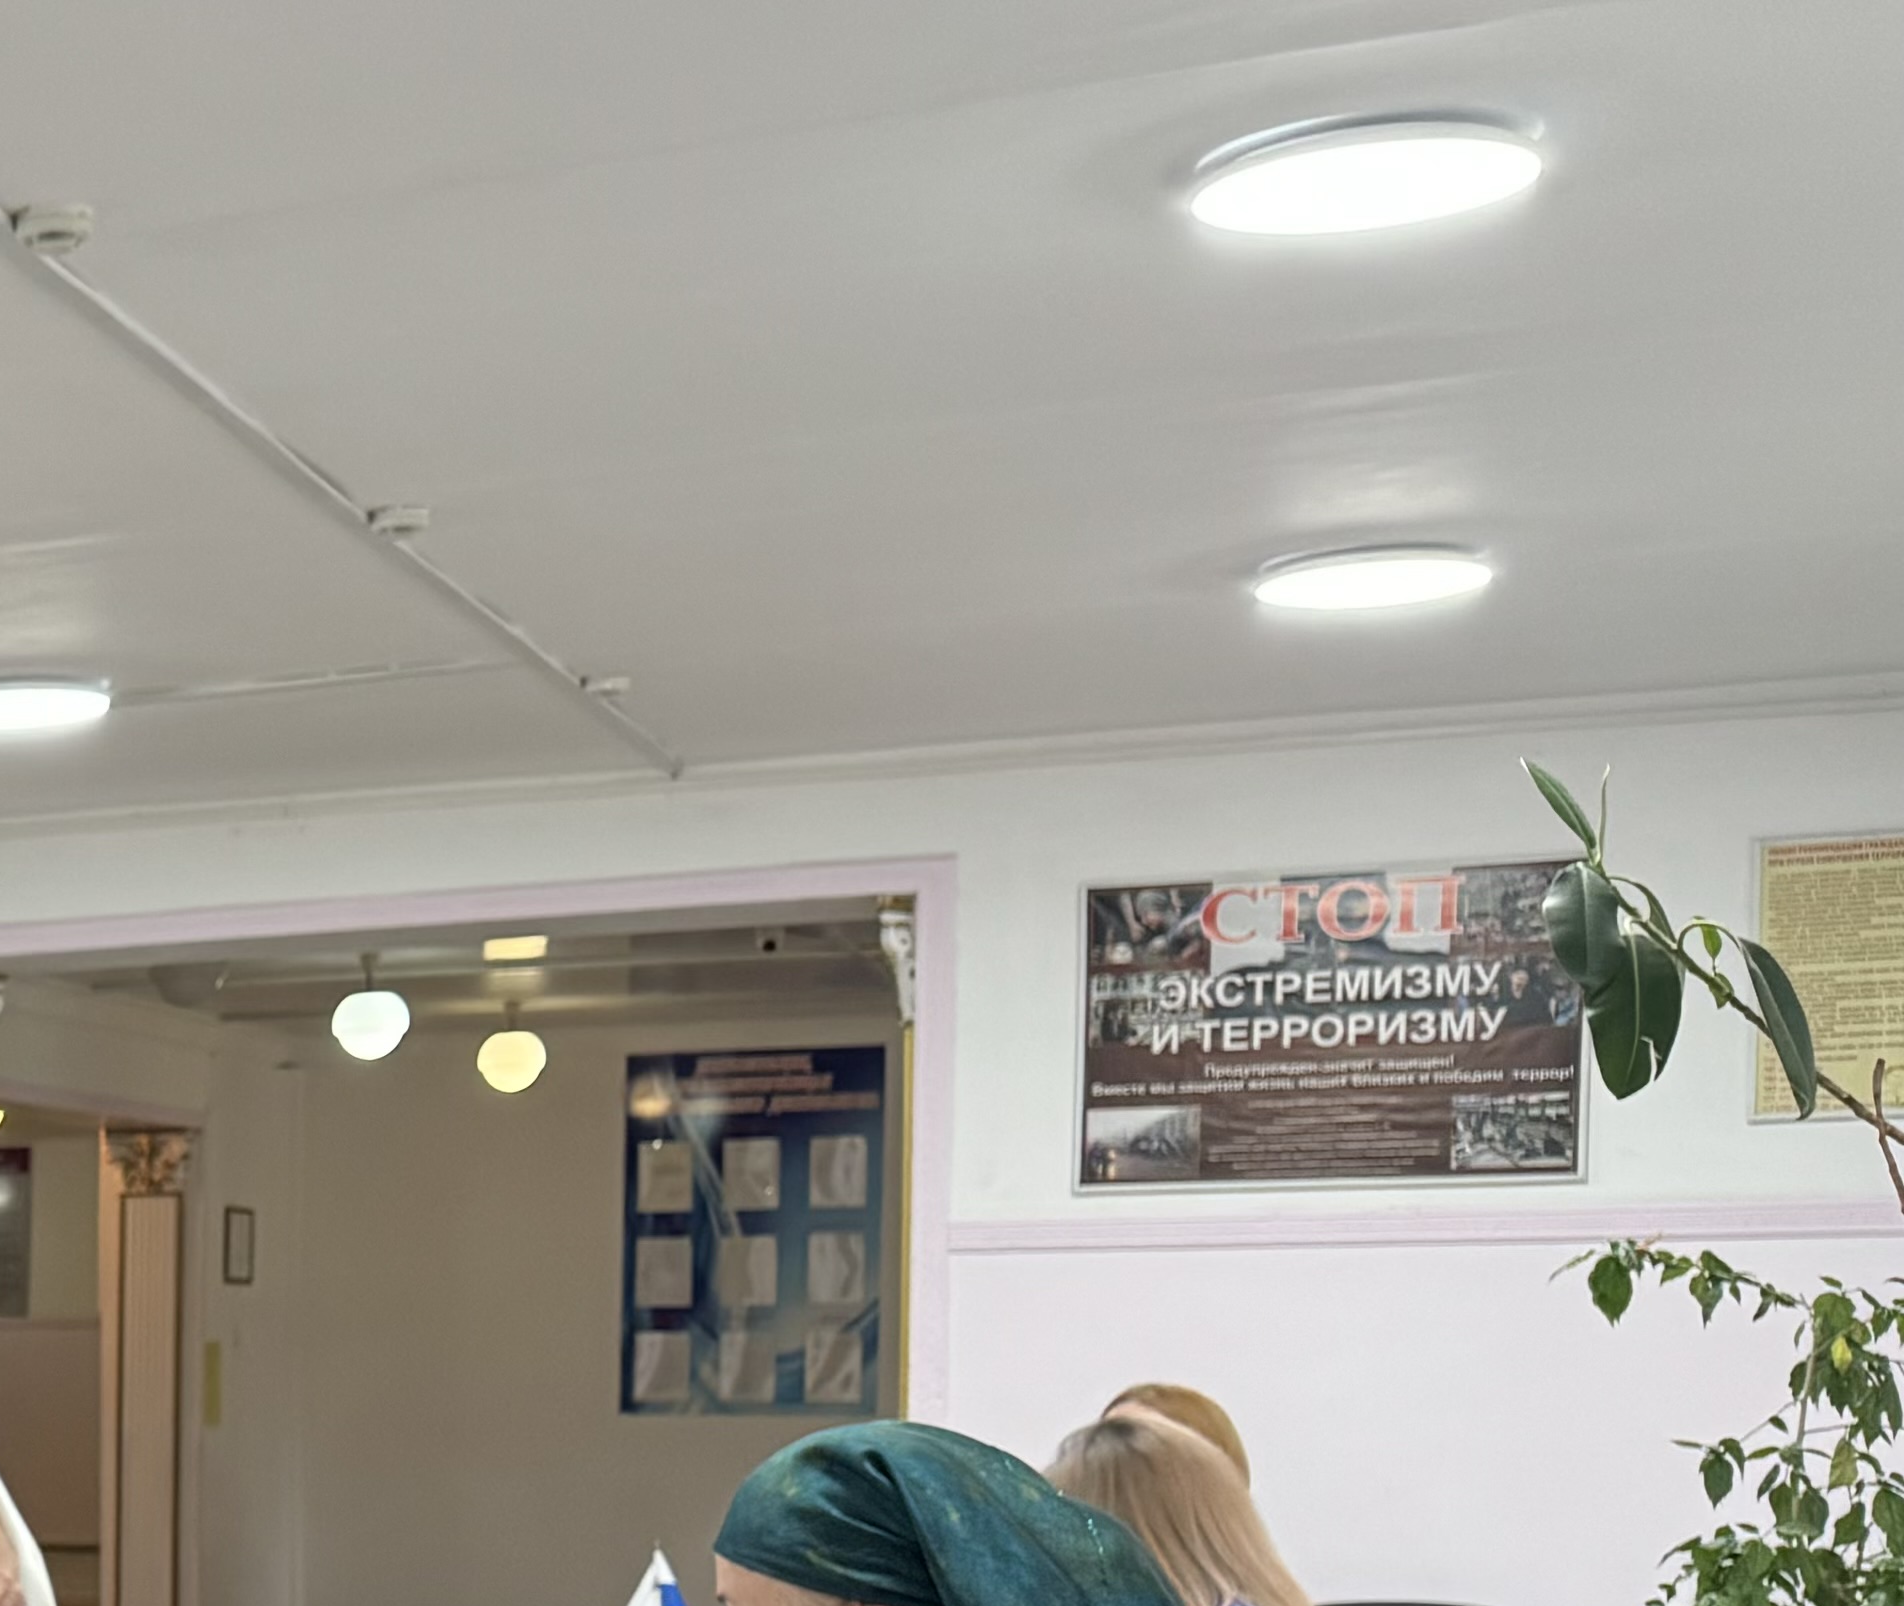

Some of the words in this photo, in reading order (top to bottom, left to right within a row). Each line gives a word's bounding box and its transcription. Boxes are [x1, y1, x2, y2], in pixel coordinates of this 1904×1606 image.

[1200, 874, 1465, 945] СТОП
[1157, 962, 1503, 1011] ЭКСТРЕМИЗМУ
[1150, 1023, 1180, 1055] И
[1198, 1006, 1508, 1053] ТЕРРОРИЗМУ
[1512, 1065, 1574, 1083] террор!
